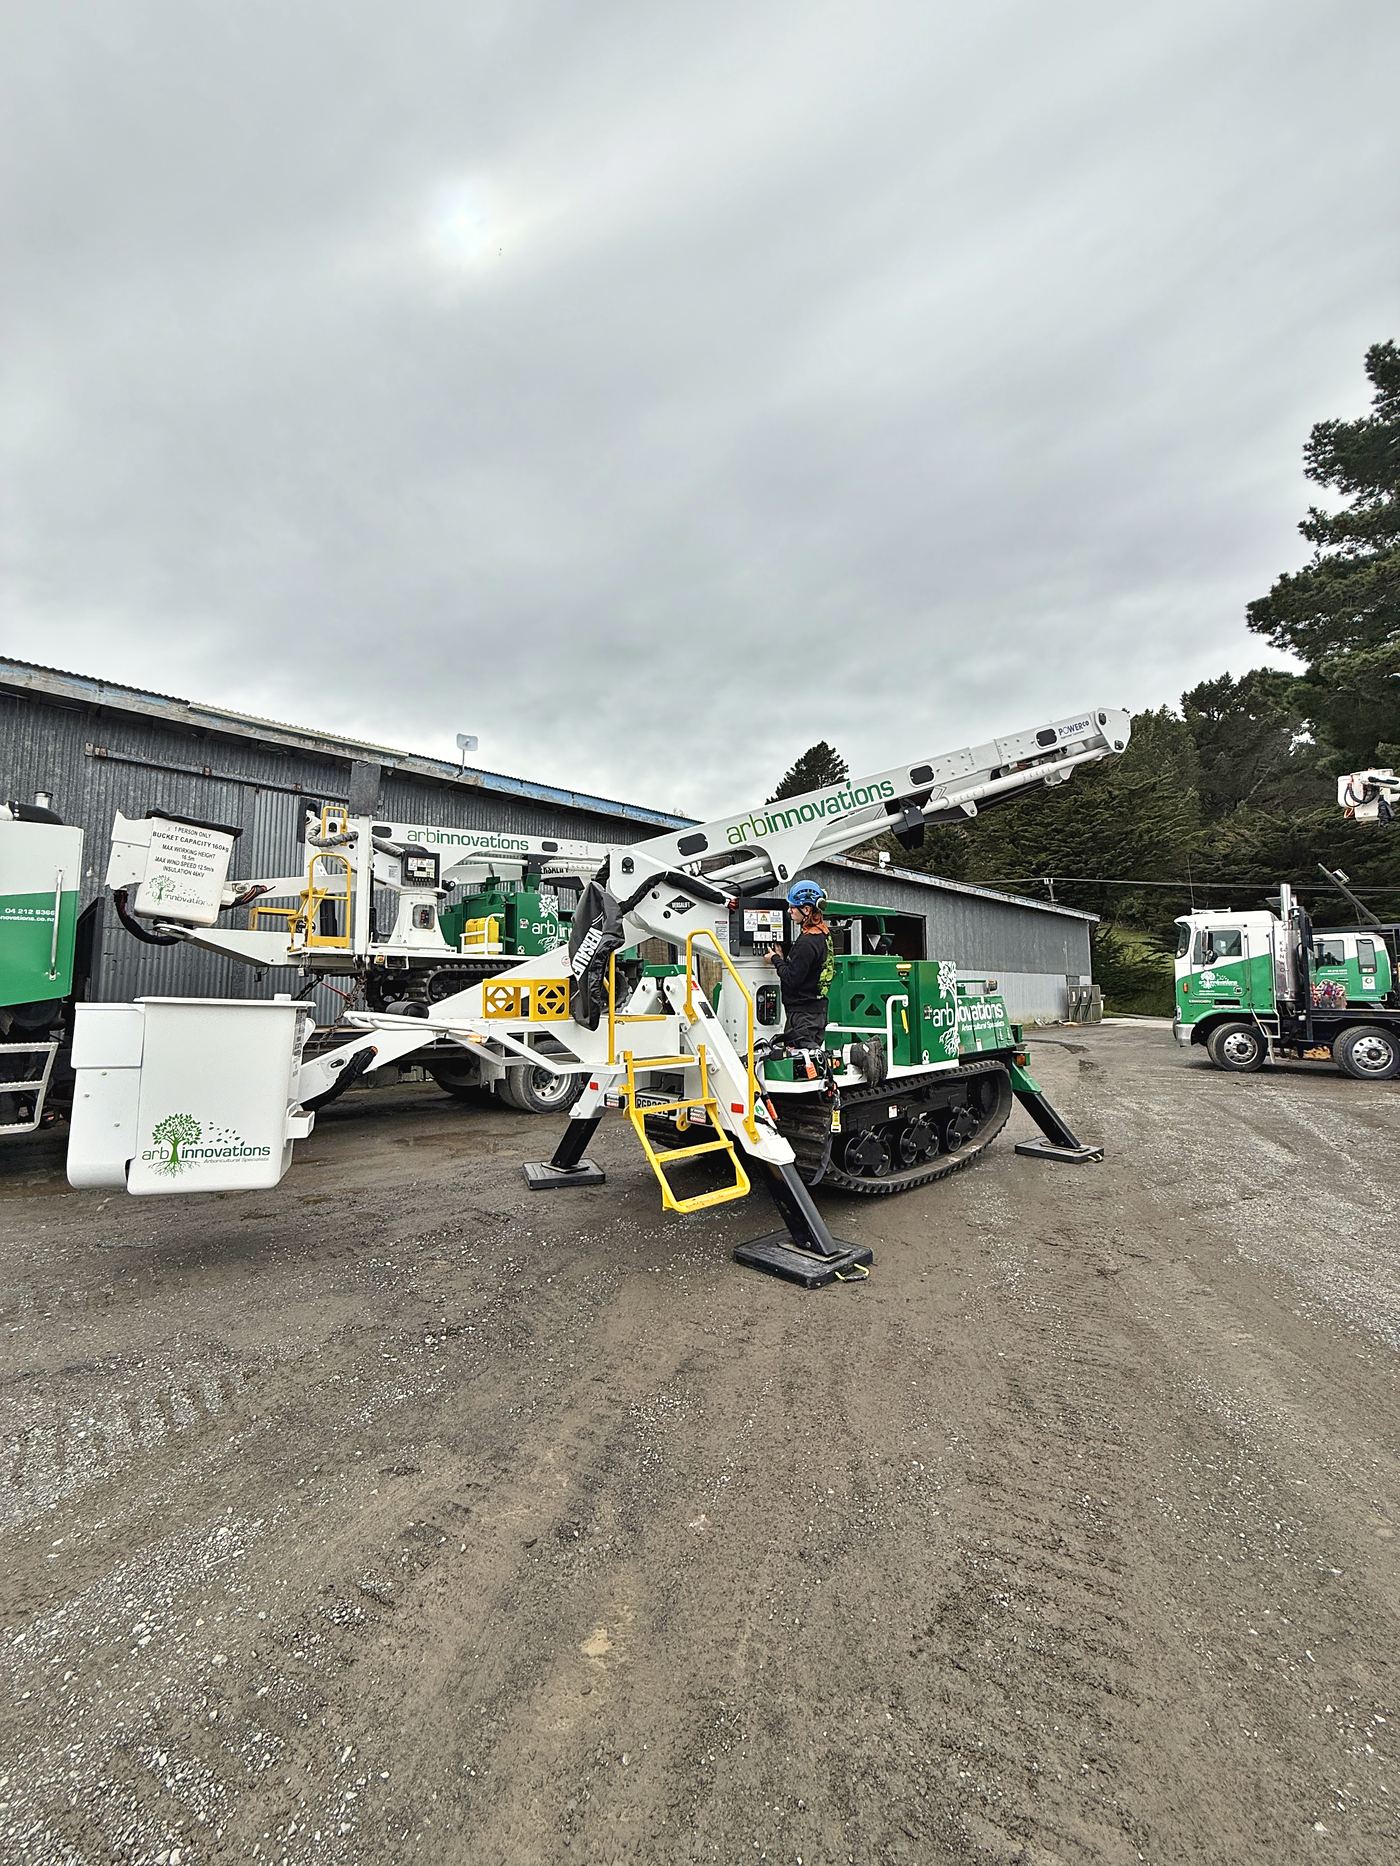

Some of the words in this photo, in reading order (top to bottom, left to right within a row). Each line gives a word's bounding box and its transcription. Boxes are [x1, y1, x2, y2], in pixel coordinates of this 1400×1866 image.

[726, 780, 895, 844] arbinnovations
[178, 827, 198, 836] PERSON
[407, 827, 529, 851] arbinnovations
[152, 831, 178, 841] BUCKET
[179, 837, 212, 848] CAPACITY
[174, 846, 198, 856] WORKING
[197, 851, 216, 859] HEIGHT
[154, 856, 166, 864] MAX
[180, 861, 197, 869] SPEED
[162, 866, 192, 876] INSULATION
[531, 919, 556, 935] arb
[932, 1002, 955, 1027] arb
[141, 1147, 169, 1160] arb
[181, 1145, 271, 1159] innovations
